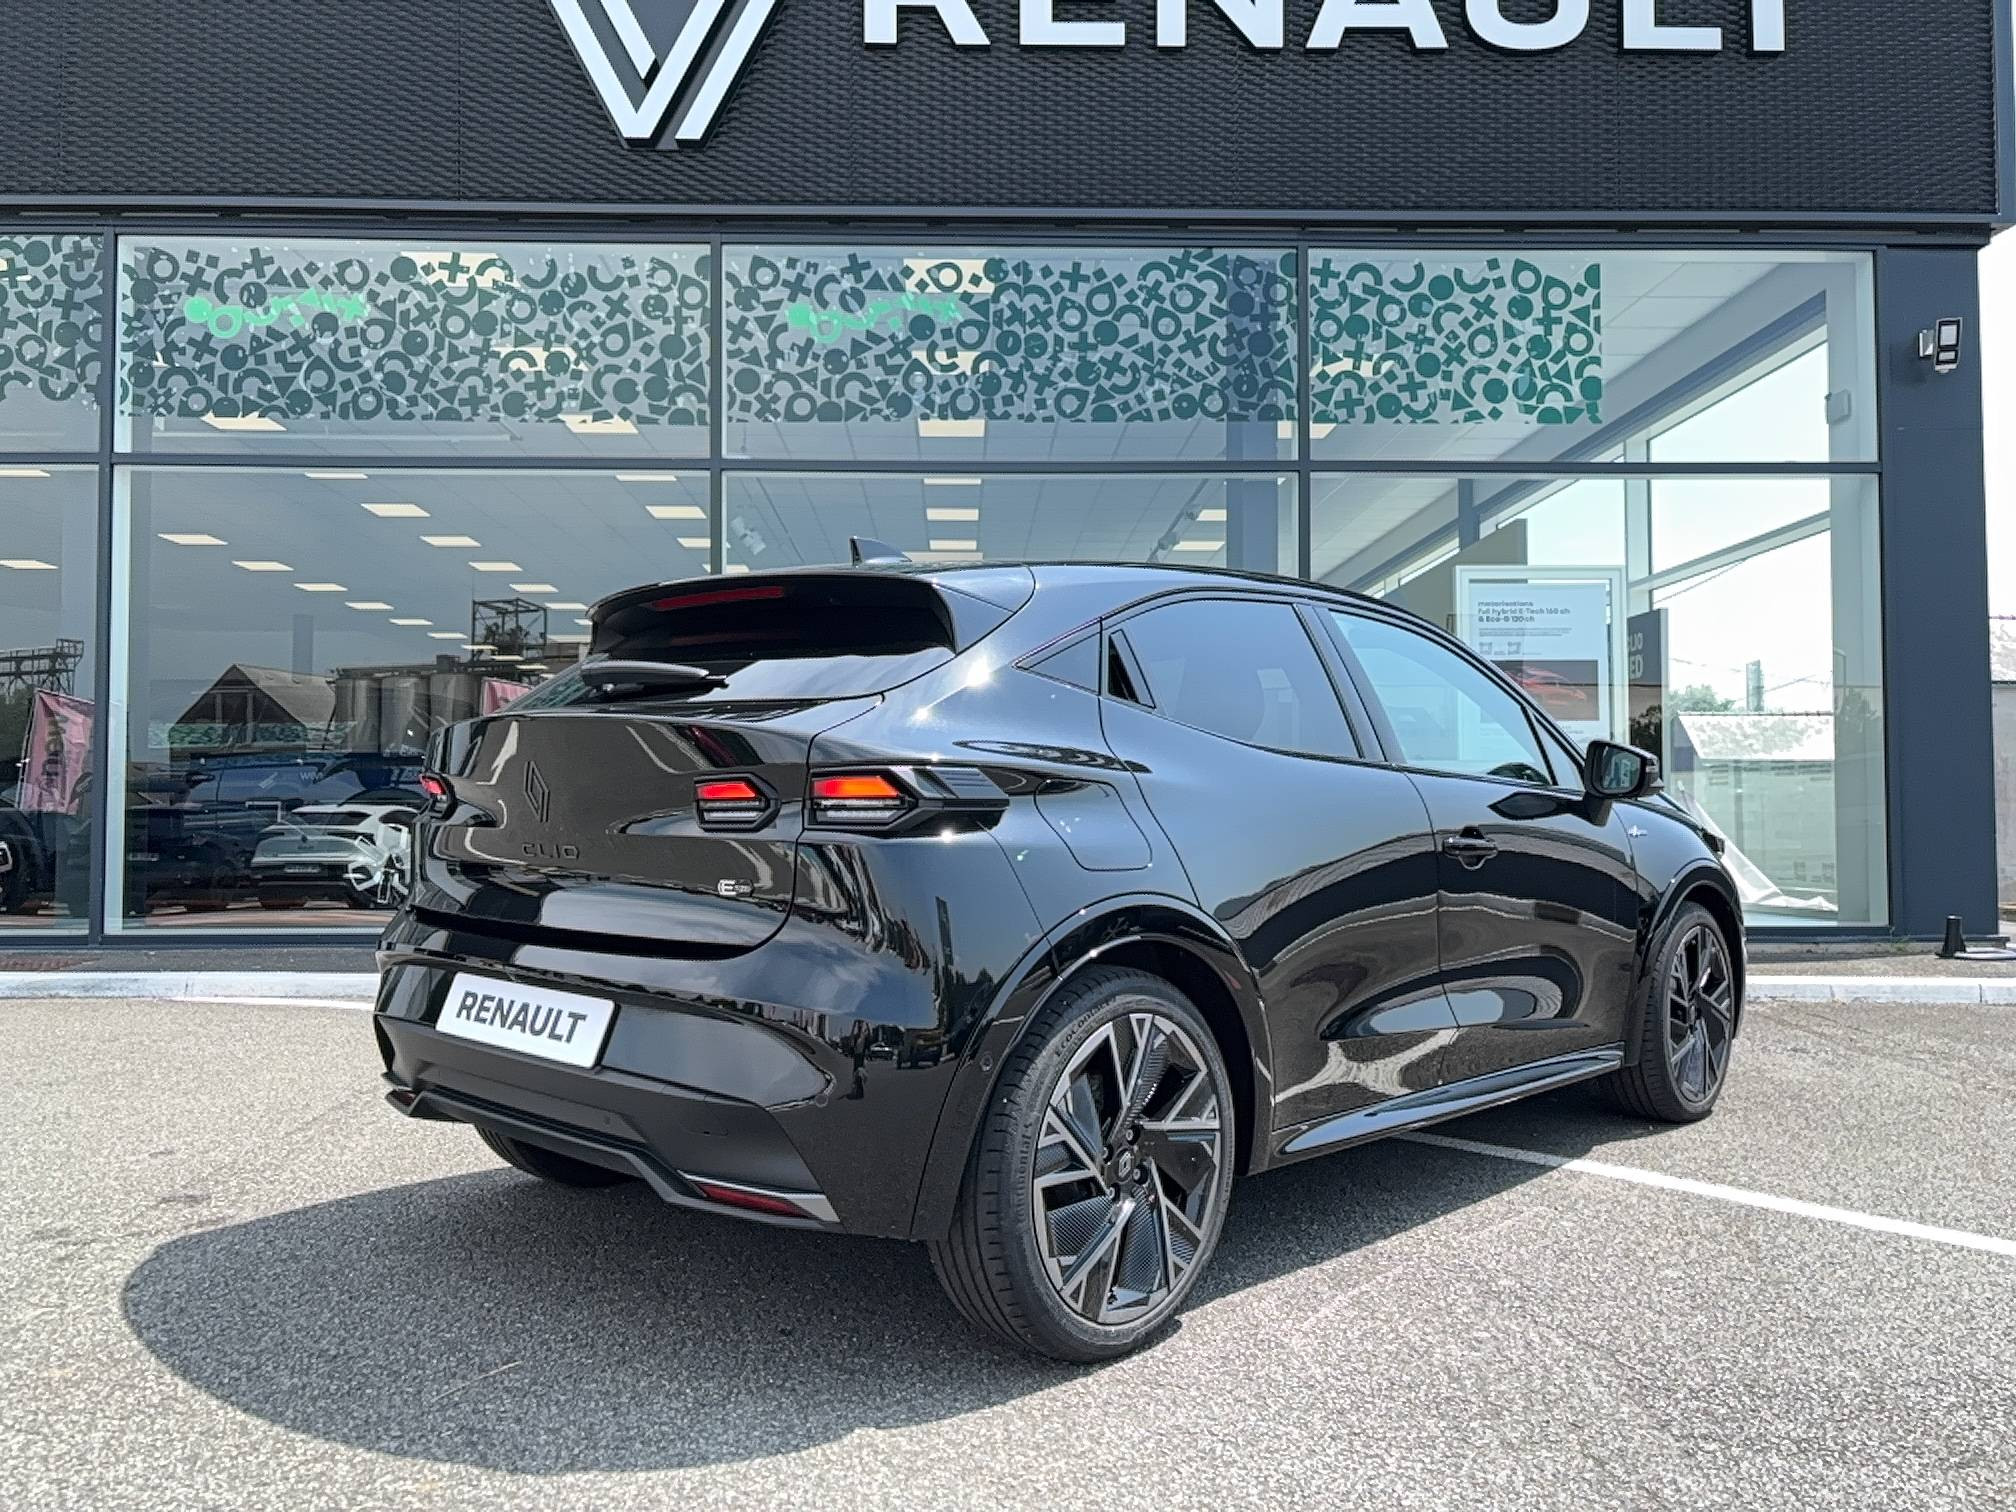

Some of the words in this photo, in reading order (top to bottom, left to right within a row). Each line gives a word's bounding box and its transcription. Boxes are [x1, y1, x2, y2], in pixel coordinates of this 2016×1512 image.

[1492, 608, 1517, 616] hybrid
[521, 842, 580, 859] CLIO
[456, 989, 588, 1044] RENAULT
